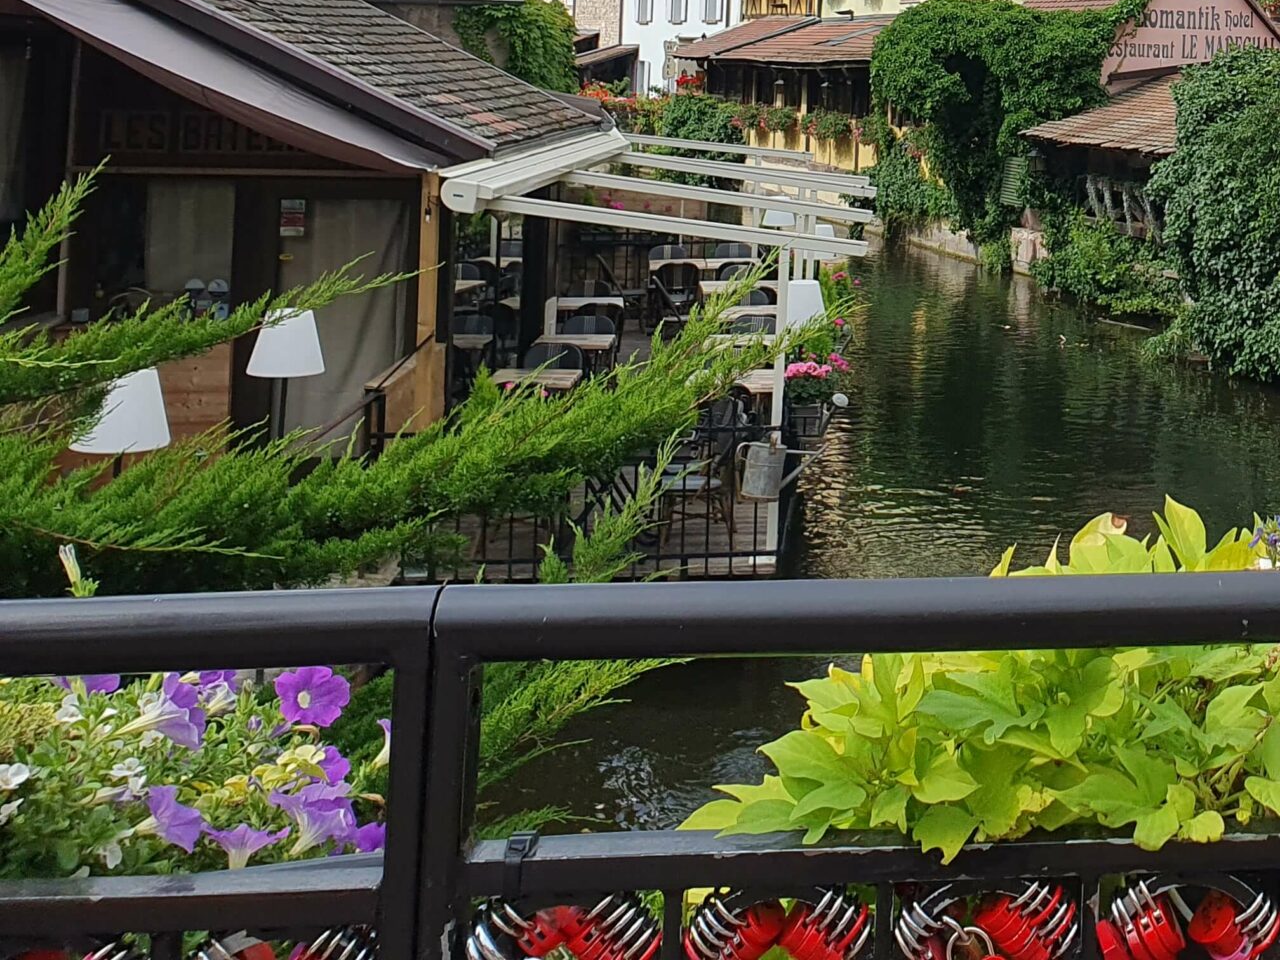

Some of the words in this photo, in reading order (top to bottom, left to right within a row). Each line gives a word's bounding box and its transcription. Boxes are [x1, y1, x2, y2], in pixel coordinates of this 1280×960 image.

[1107, 40, 1175, 59] estaurant
[1181, 34, 1198, 59] LE
[103, 113, 166, 150] LES
